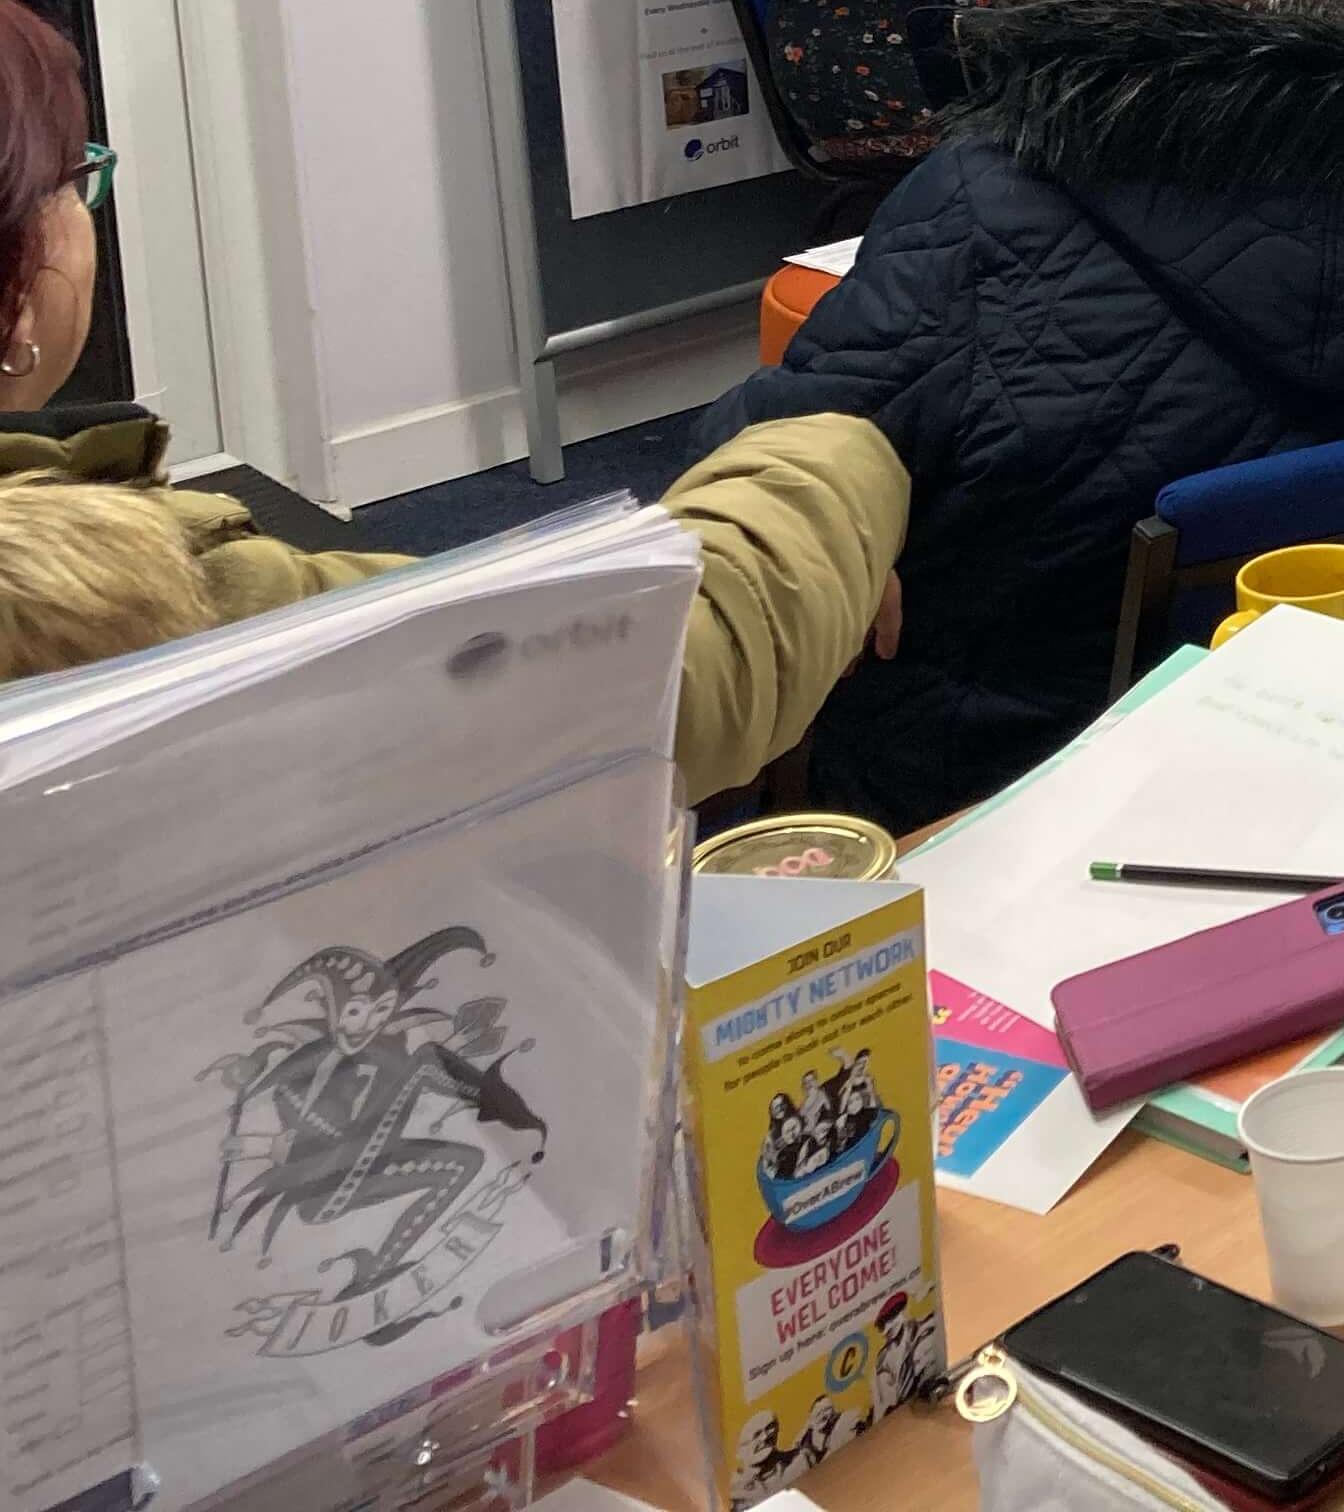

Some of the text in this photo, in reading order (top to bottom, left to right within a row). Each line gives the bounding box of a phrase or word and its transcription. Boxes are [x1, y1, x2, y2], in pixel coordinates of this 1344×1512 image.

[645, 0, 710, 16] Every Wednesday
[706, 135, 740, 158] orbit
[787, 933, 852, 975] JOIN OUR
[715, 938, 915, 1046] MIGHTY NETWORK
[724, 1078, 741, 1092] for
[743, 1058, 780, 1085] people
[782, 1052, 793, 1065] to
[795, 1039, 819, 1056] look
[821, 1029, 839, 1044] out
[841, 1021, 856, 1033] for
[858, 1007, 883, 1027] each
[751, 1040, 782, 1061] come
[785, 1024, 814, 1044] along
[816, 1016, 828, 1028] to
[829, 1001, 863, 1022] online
[287, 1234, 476, 1351] JOKER
[770, 1220, 892, 1318] EVERYONE
[749, 1359, 776, 1382] Sign
[780, 1347, 794, 1365] up
[839, 1346, 857, 1379] C
